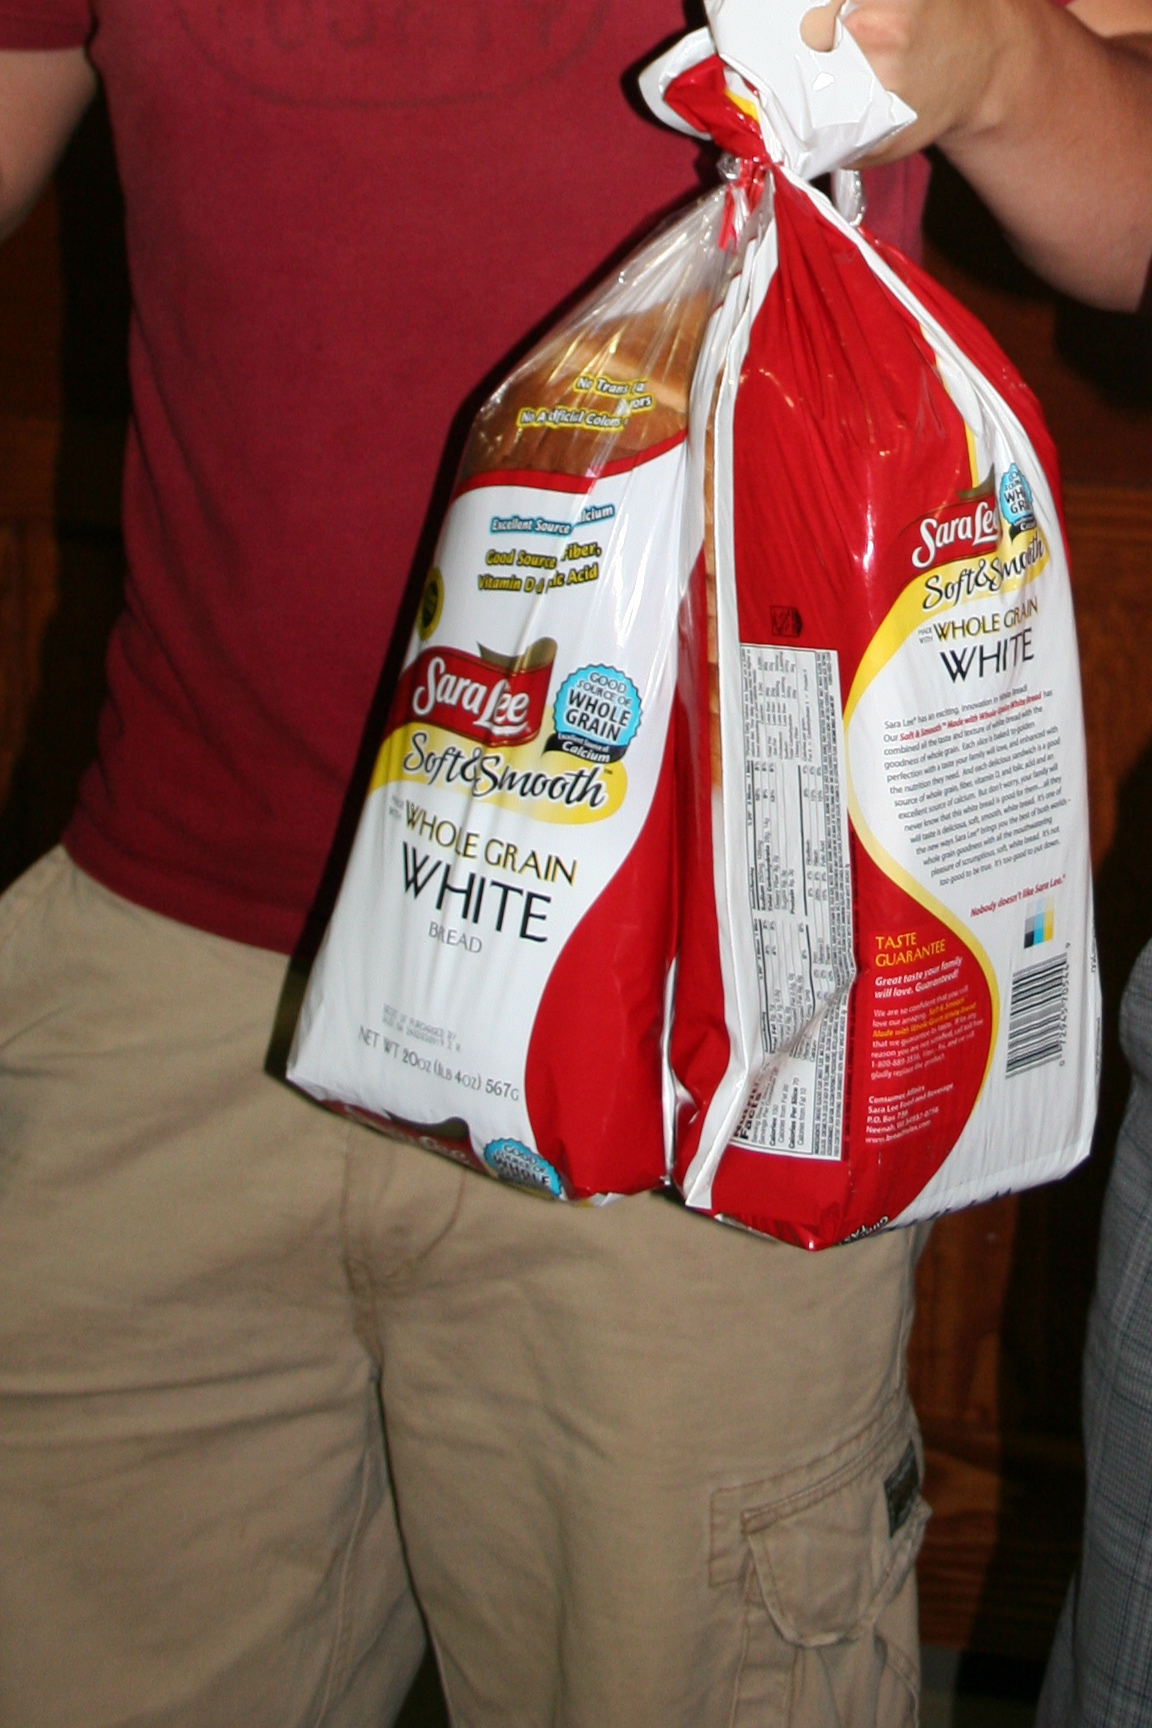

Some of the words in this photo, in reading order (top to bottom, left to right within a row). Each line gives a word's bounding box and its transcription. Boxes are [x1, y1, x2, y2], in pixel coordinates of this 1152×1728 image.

[491, 517, 532, 532] Excellent
[535, 522, 571, 535] Source
[486, 547, 514, 565] Good
[517, 551, 557, 569] Source
[911, 516, 973, 570] Sara
[478, 574, 521, 591] Vitamin
[568, 564, 599, 584] Acid
[933, 612, 1001, 644] WHOLE
[1003, 595, 1039, 629] GRAIN
[939, 627, 1035, 684] WHITE
[413, 657, 480, 716] Sara
[474, 679, 531, 735] Lee
[576, 679, 618, 701] SOURCE
[618, 694, 632, 707] OF
[590, 672, 627, 694] GOOD
[569, 689, 632, 726] WHOLE
[565, 708, 622, 742] GRAIN
[562, 741, 611, 763] Calcium
[404, 799, 480, 859] WHOLE
[484, 838, 578, 887] GRAIN
[402, 841, 552, 943] WHITE
[428, 921, 483, 954] BREAD
[875, 931, 917, 950] TASTE
[875, 938, 946, 967] GUARANTEE
[875, 976, 903, 987] Great
[903, 971, 923, 984] taste
[941, 955, 963, 972] family
[874, 987, 892, 999] will
[893, 985, 914, 998] love.
[358, 1026, 380, 1048] NET
[383, 1037, 400, 1059] WT
